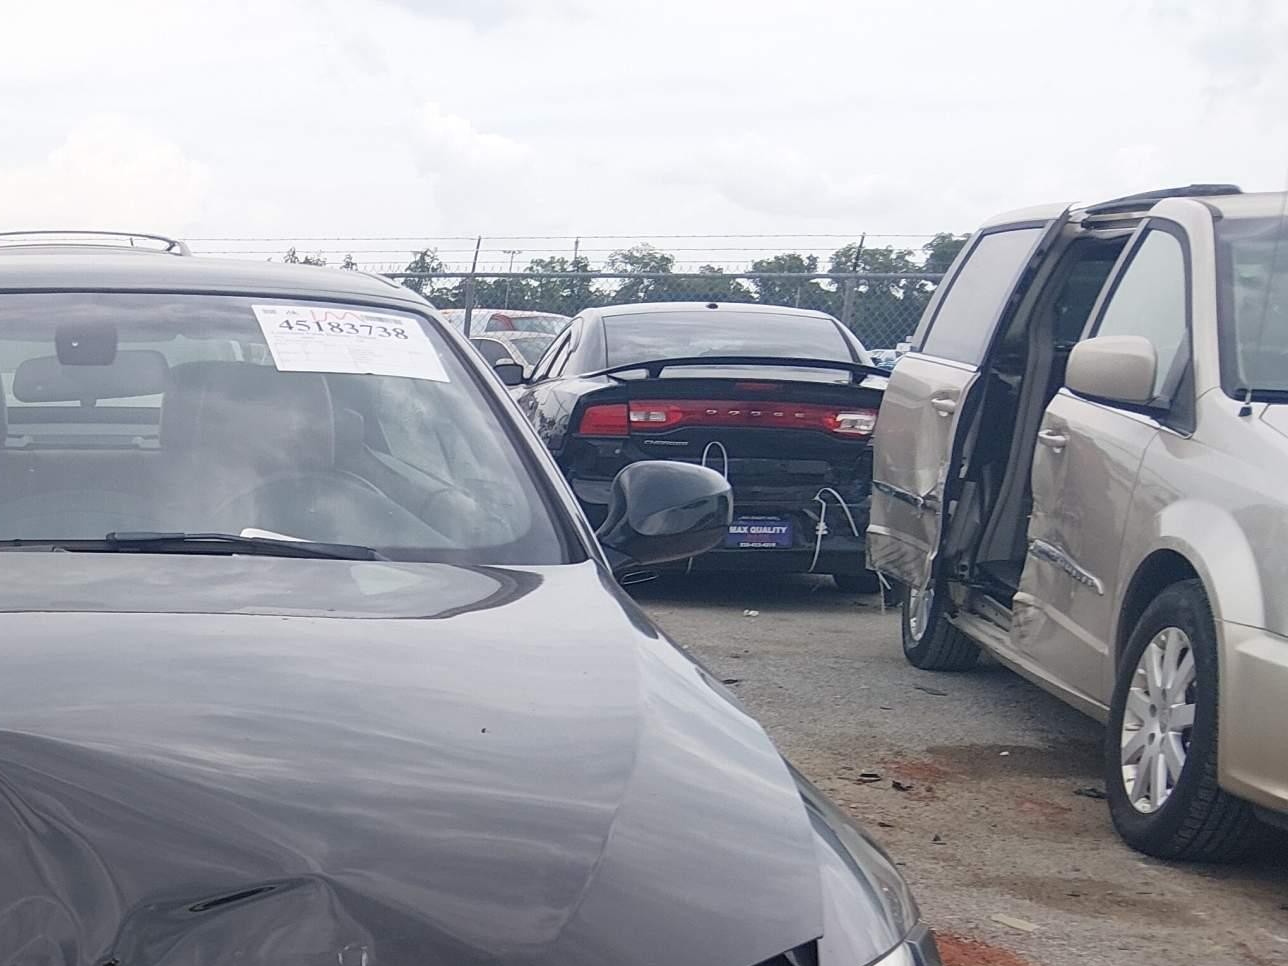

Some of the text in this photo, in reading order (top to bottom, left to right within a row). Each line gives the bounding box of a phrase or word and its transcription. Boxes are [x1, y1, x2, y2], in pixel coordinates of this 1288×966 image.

[278, 318, 409, 340] 45183738
[729, 526, 788, 534] MAX QUALITY
